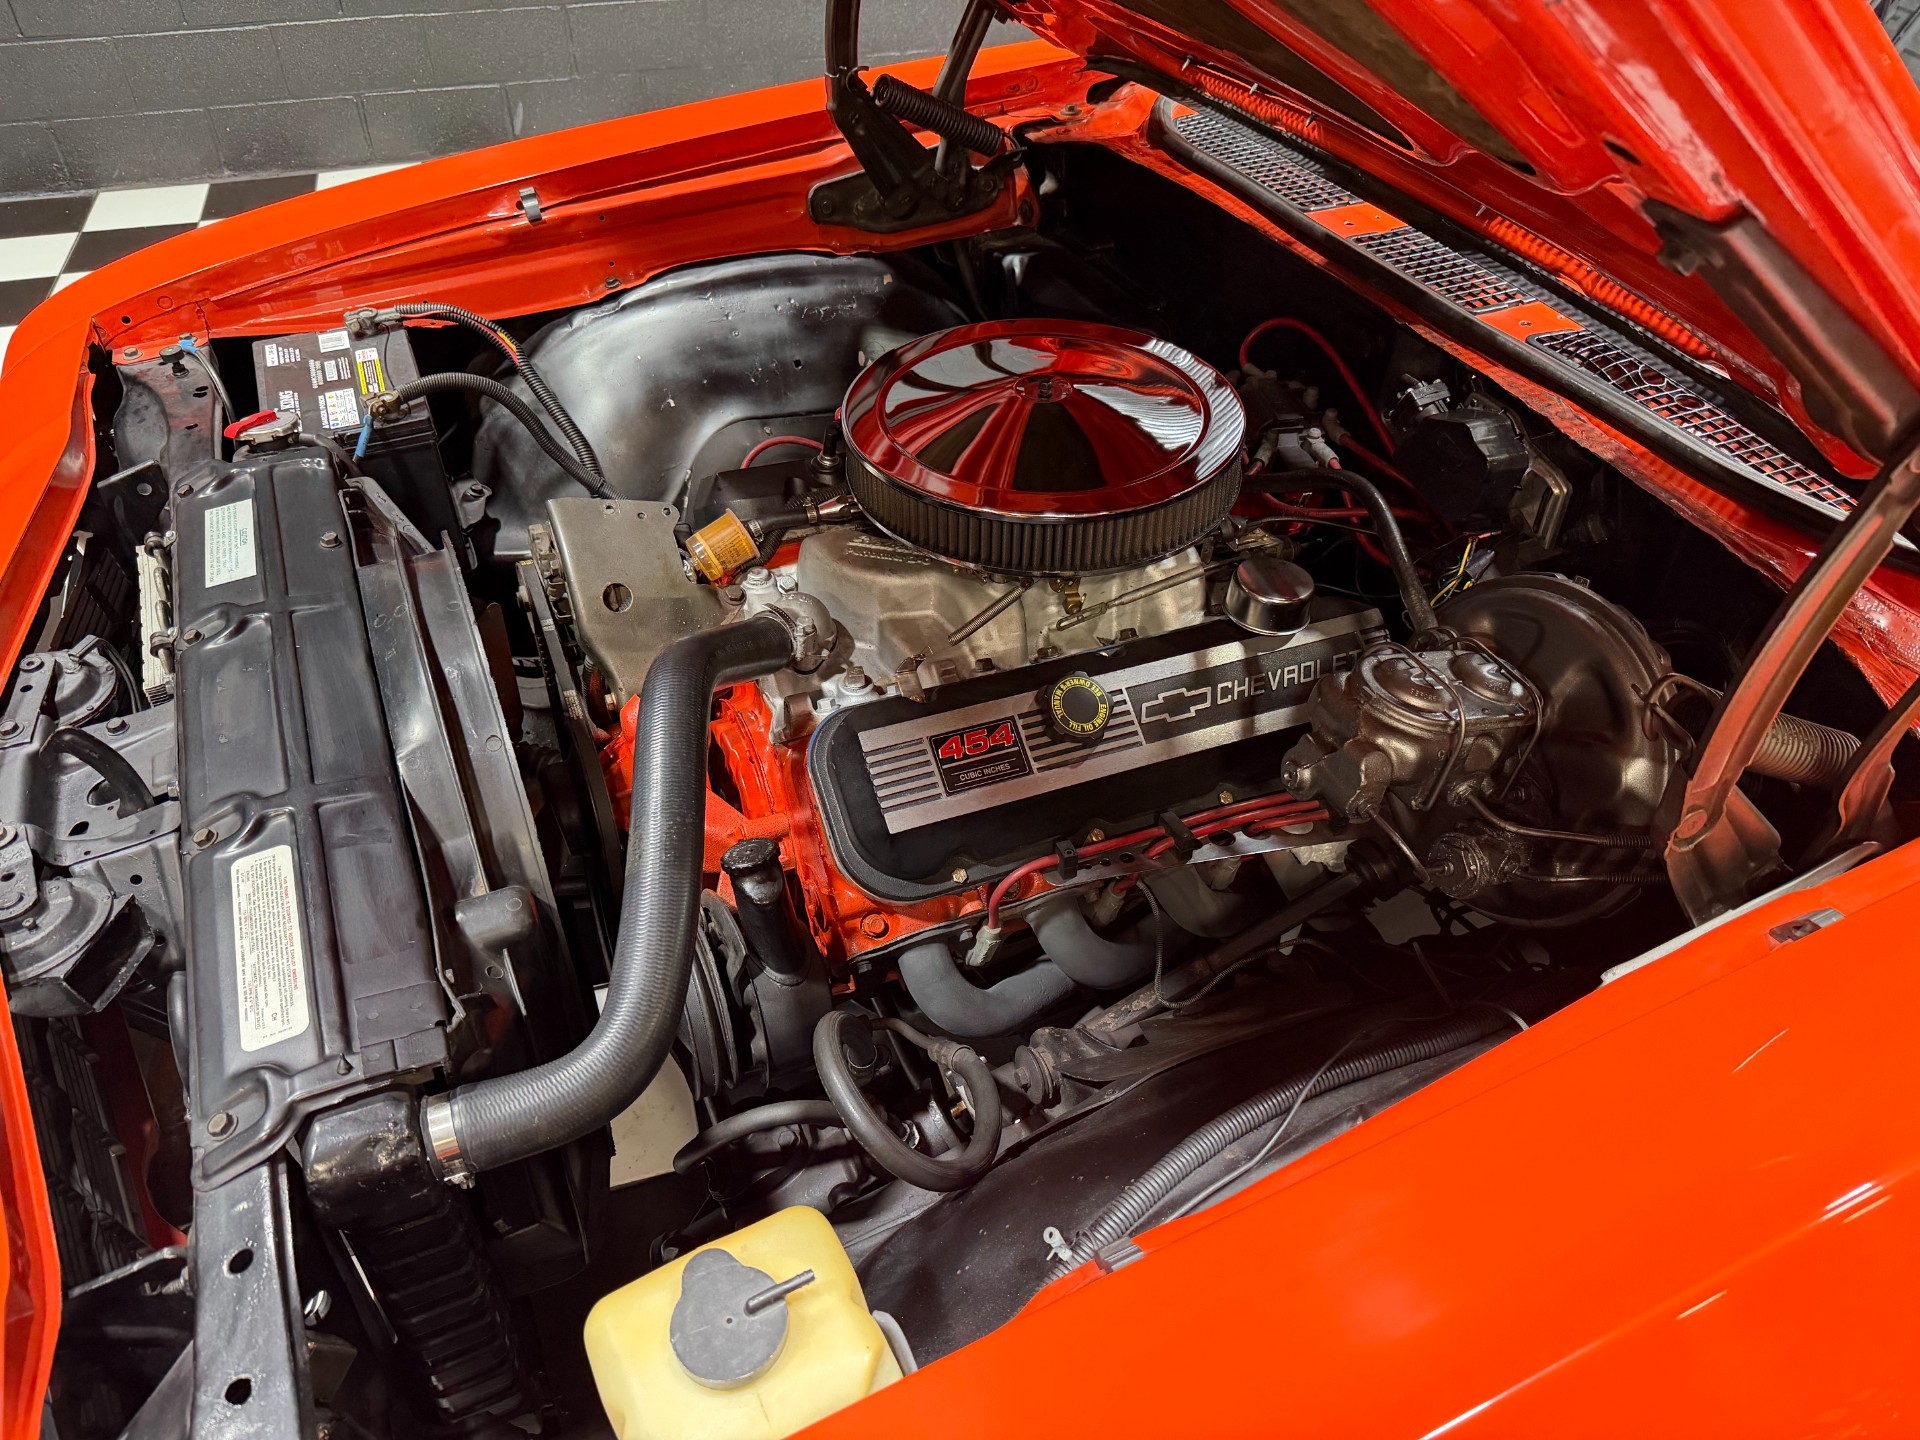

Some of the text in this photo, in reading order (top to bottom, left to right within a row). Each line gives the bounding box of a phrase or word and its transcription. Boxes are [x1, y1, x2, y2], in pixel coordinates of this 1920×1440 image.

[1217, 650, 1362, 704] CHEVROLET
[1054, 678, 1102, 719] SEE OWNER'S MANUAL
[1068, 704, 1107, 732] ENGINE OIL FILL
[939, 722, 1014, 759] 454
[960, 763, 1010, 781] CUBIC INCHES
